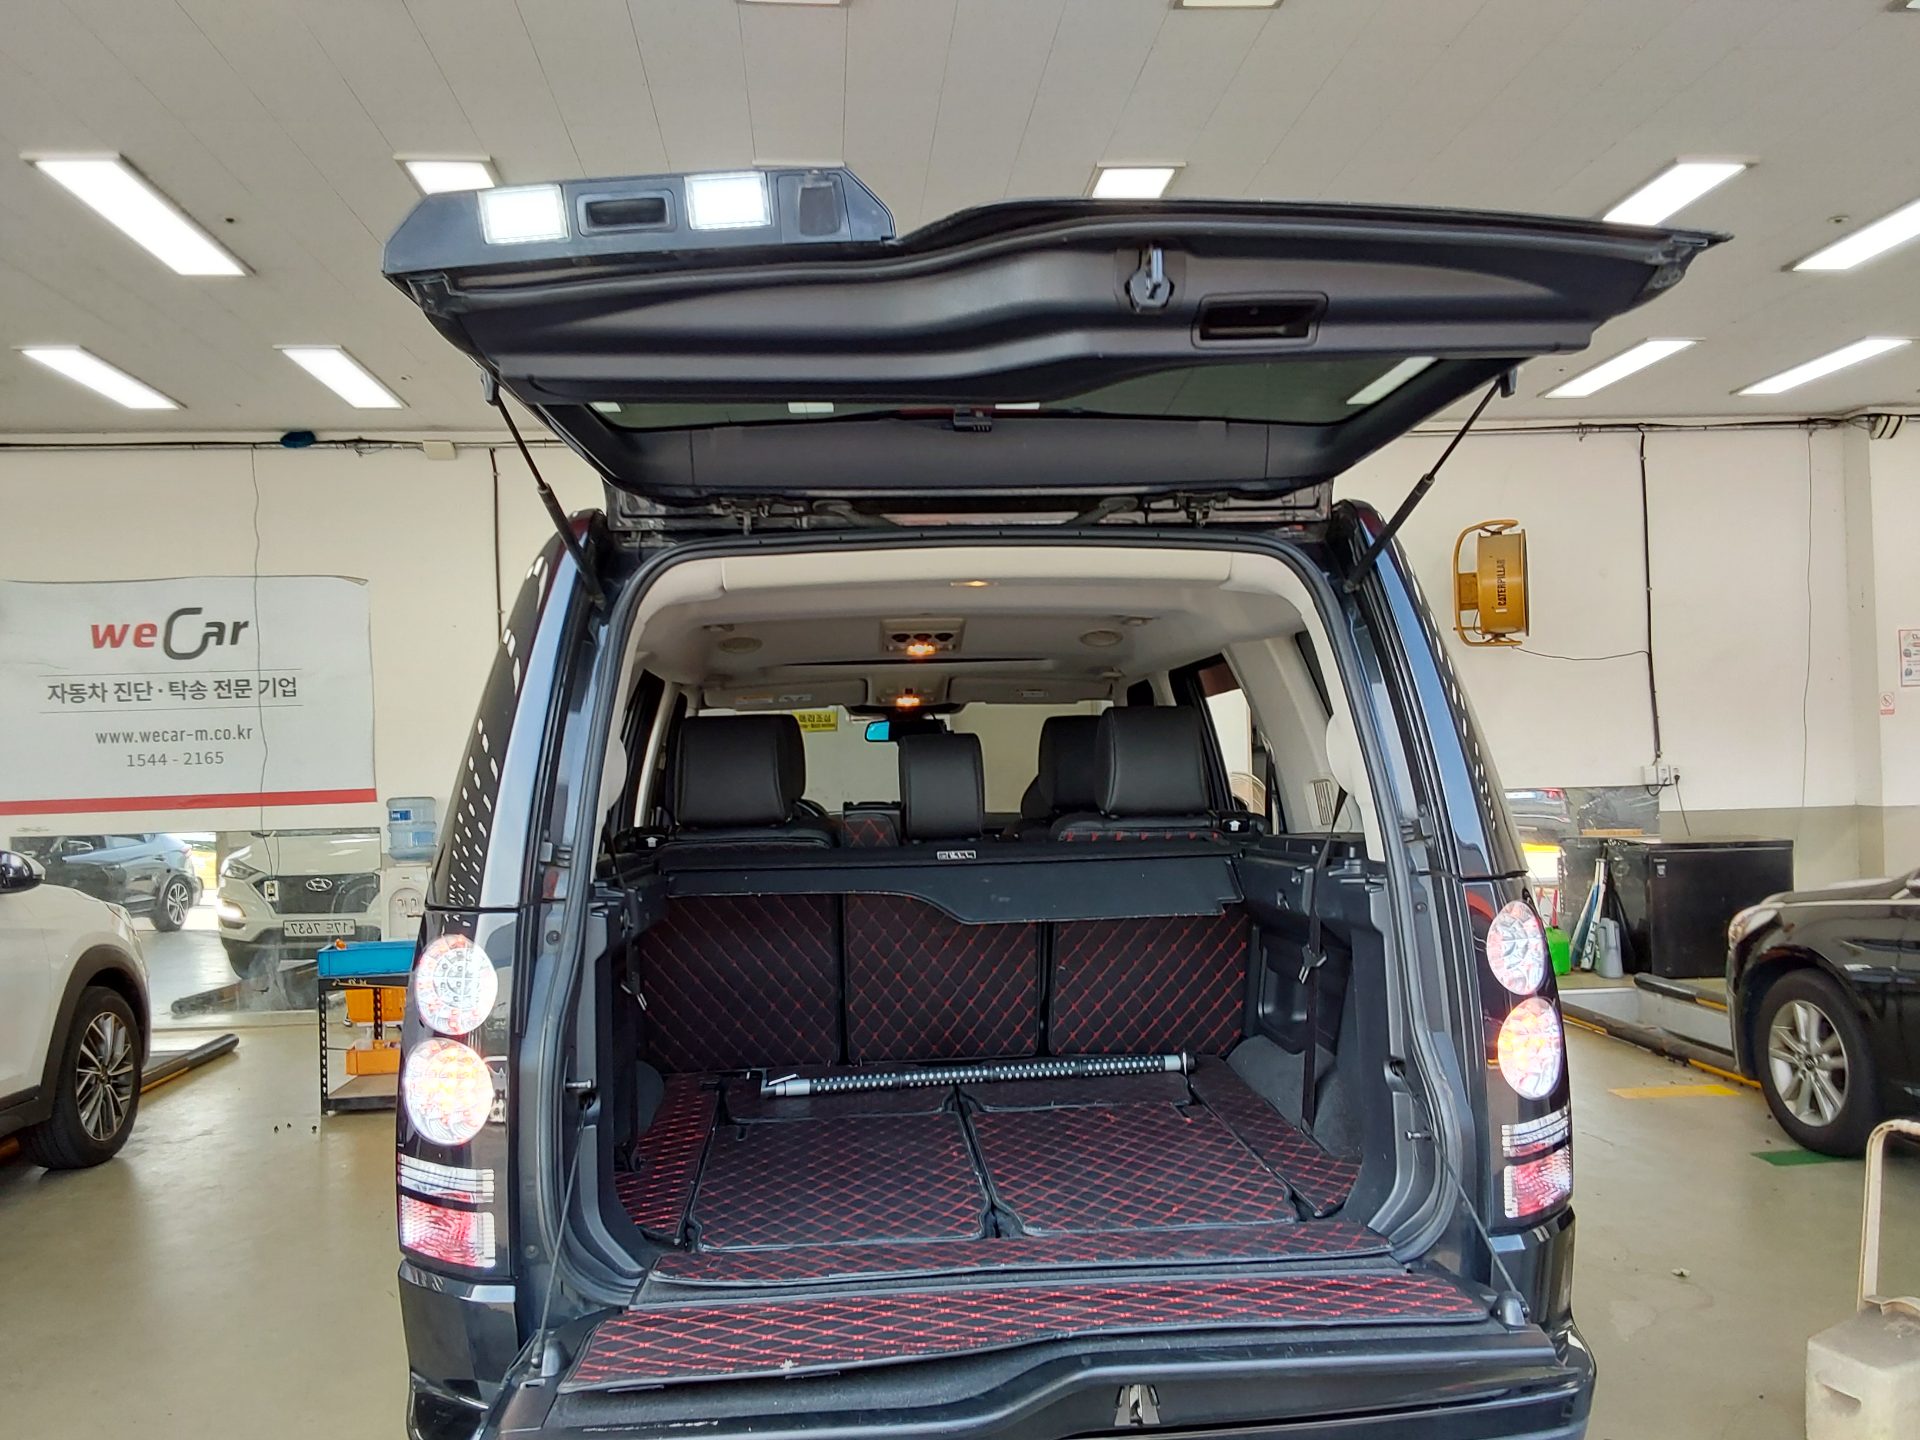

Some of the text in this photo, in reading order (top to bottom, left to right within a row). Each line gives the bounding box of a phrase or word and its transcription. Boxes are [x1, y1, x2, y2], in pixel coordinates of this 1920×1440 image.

[47, 682, 108, 705] 자동차
[213, 678, 253, 700] 전문
[259, 676, 297, 699] 기업
[95, 724, 253, 745] www.wecar-m.co.kr
